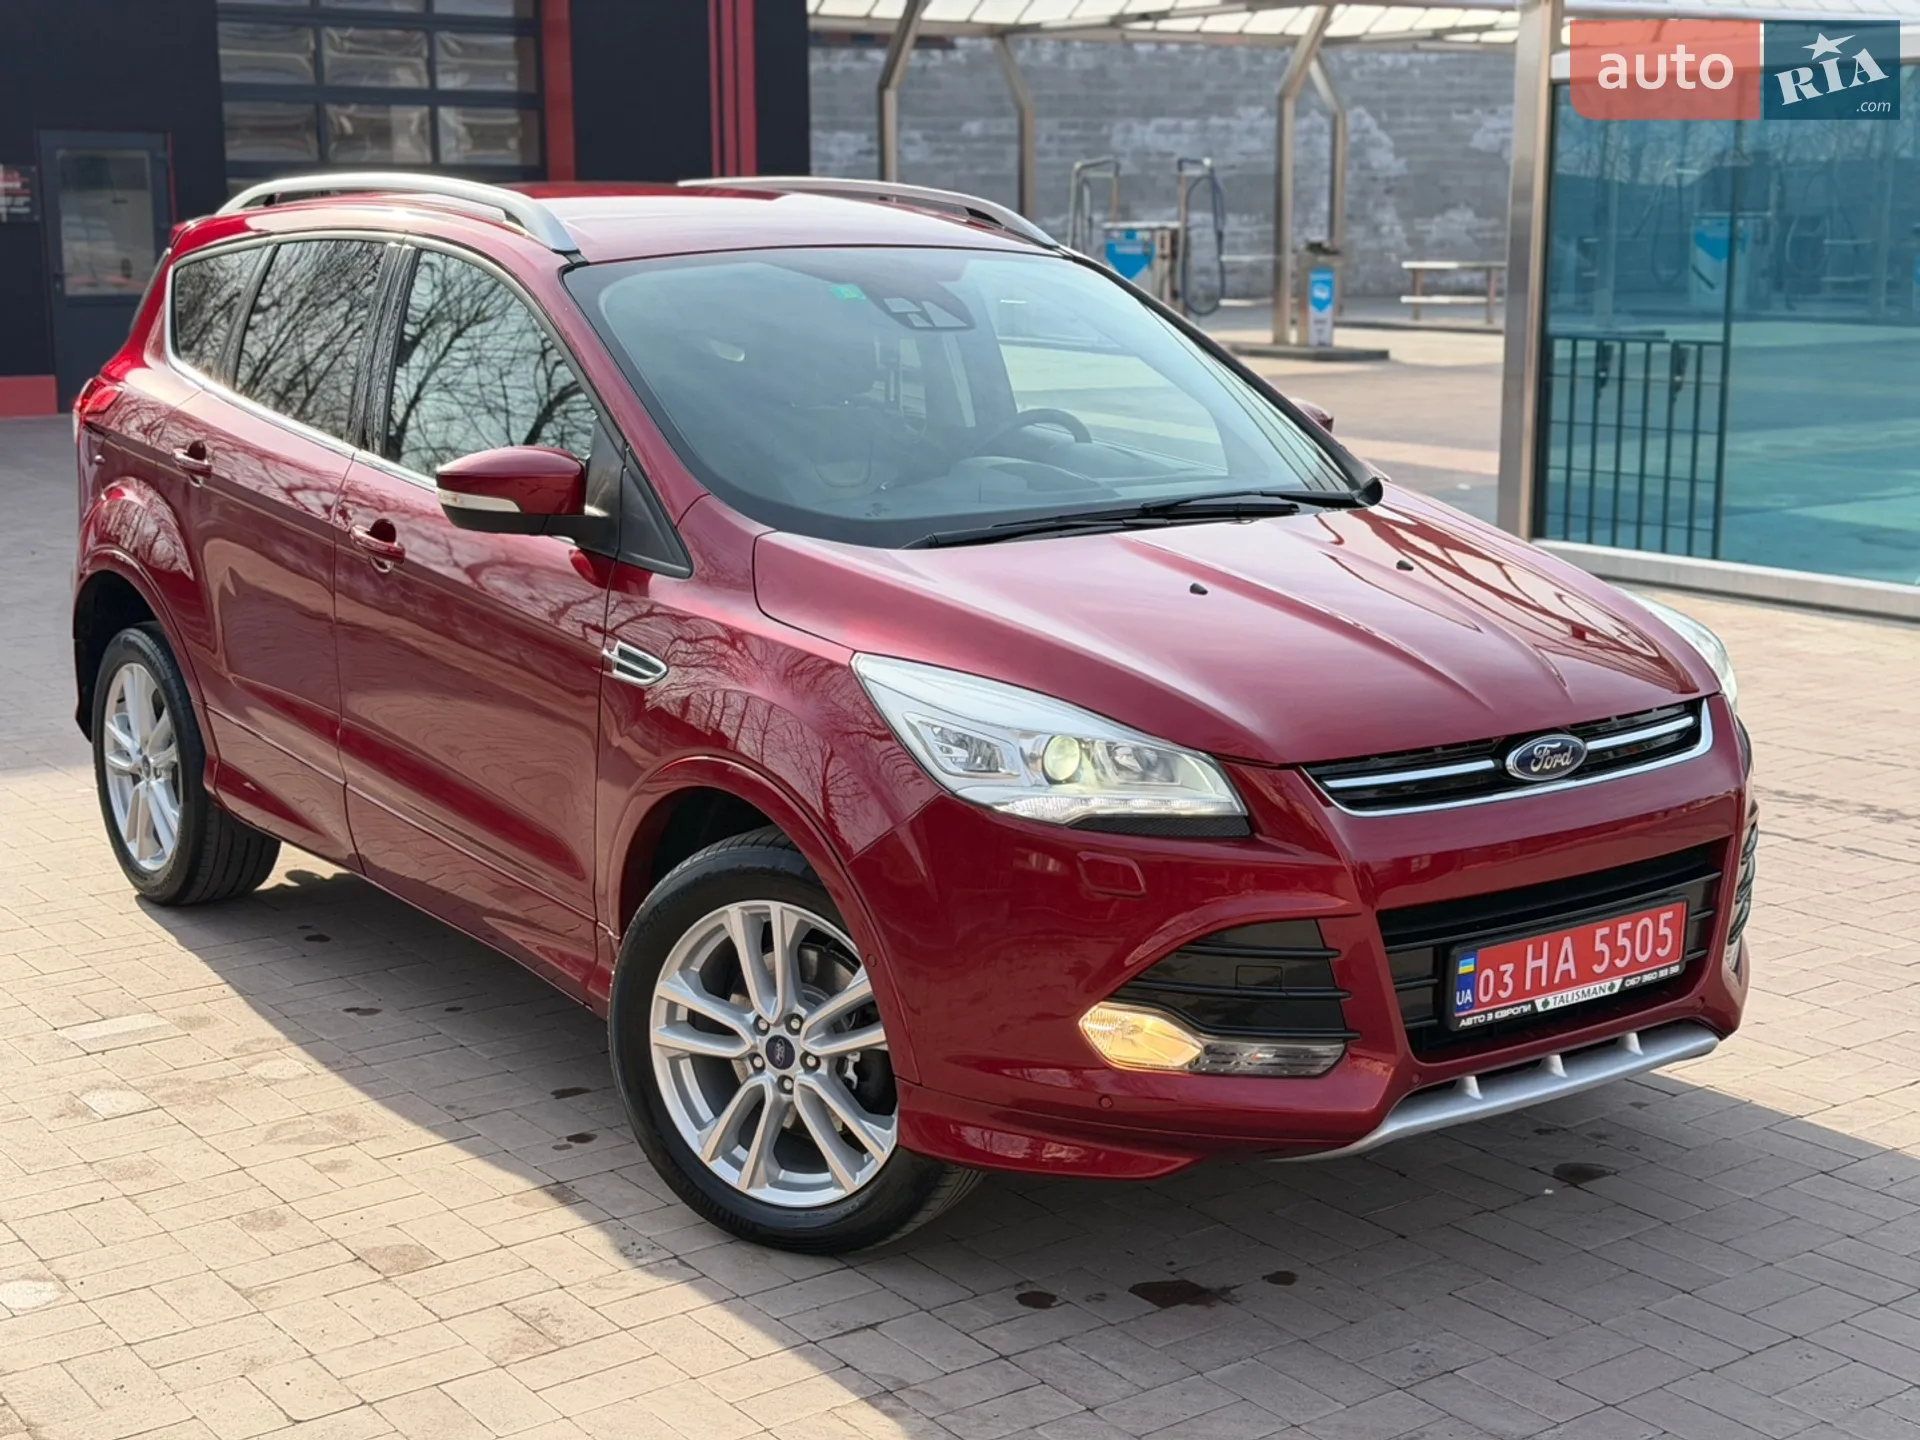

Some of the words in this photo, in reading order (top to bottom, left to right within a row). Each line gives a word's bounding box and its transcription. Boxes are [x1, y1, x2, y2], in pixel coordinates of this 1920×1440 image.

[1530, 742, 1573, 772] Ford
[1478, 963, 1514, 1003] 03
[1525, 936, 1577, 991] HA
[1592, 911, 1674, 974] 5505
[1456, 989, 1473, 1005] UA
[1552, 985, 1607, 1006] TALISMAN
[1459, 1015, 1485, 1028] АВТО
[1495, 1003, 1532, 1019] ЄВРОПИ
